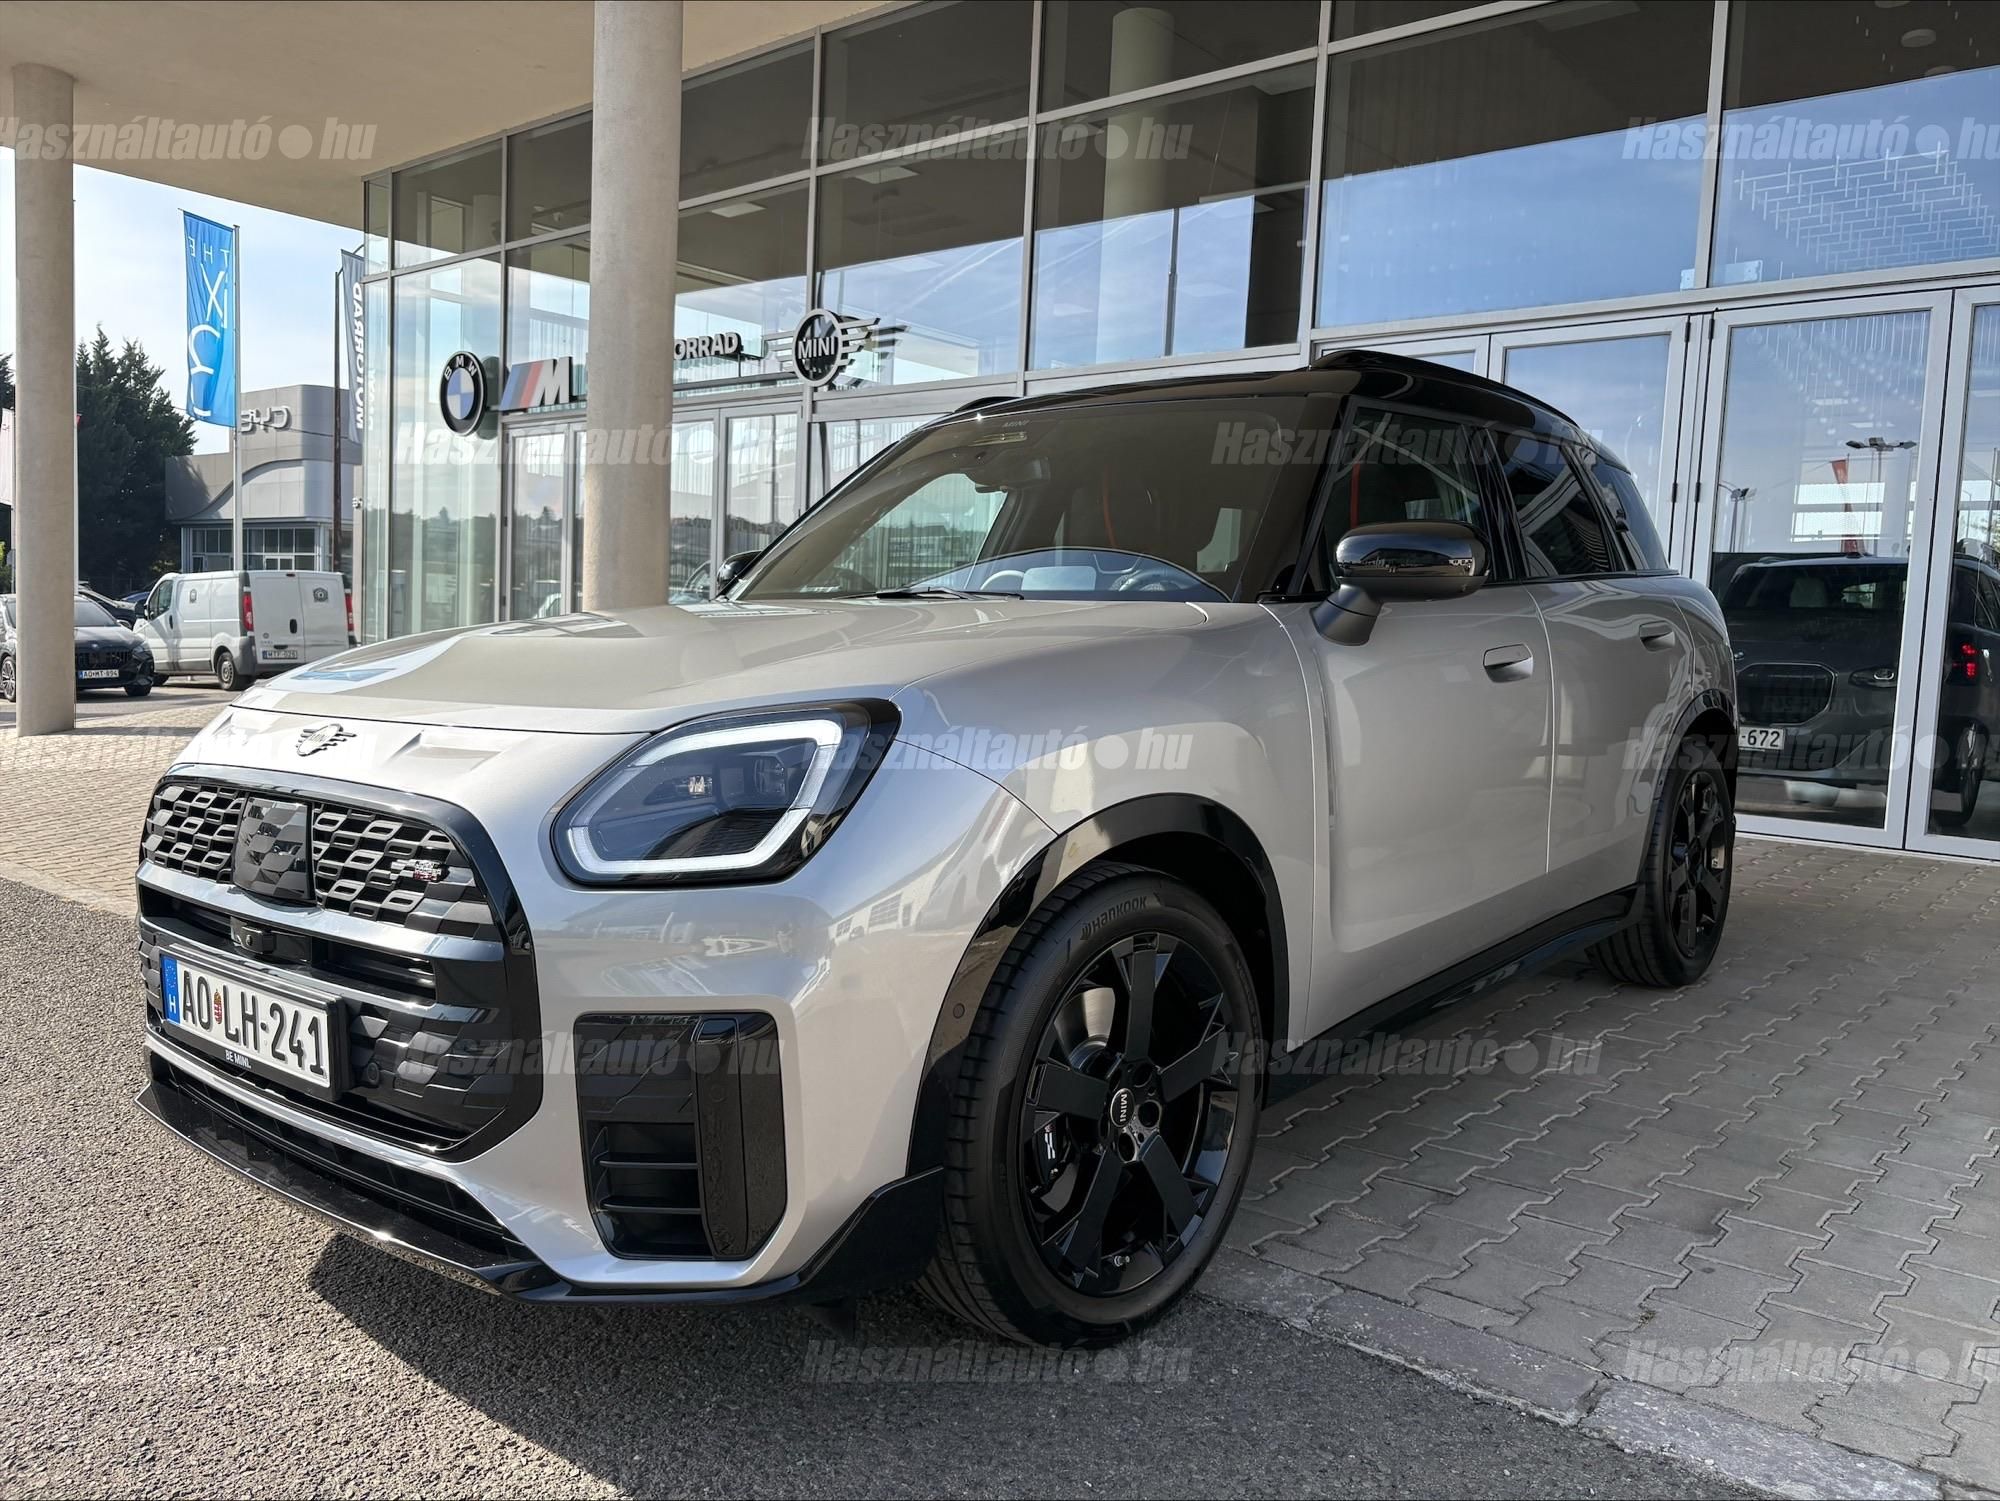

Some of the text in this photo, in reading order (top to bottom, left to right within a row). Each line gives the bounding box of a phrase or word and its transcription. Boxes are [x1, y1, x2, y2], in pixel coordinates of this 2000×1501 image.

[797, 335, 837, 361] MINI
[444, 354, 478, 381] BMW
[223, 984, 324, 1076] LH-241
[1119, 1093, 1128, 1122] MINI
